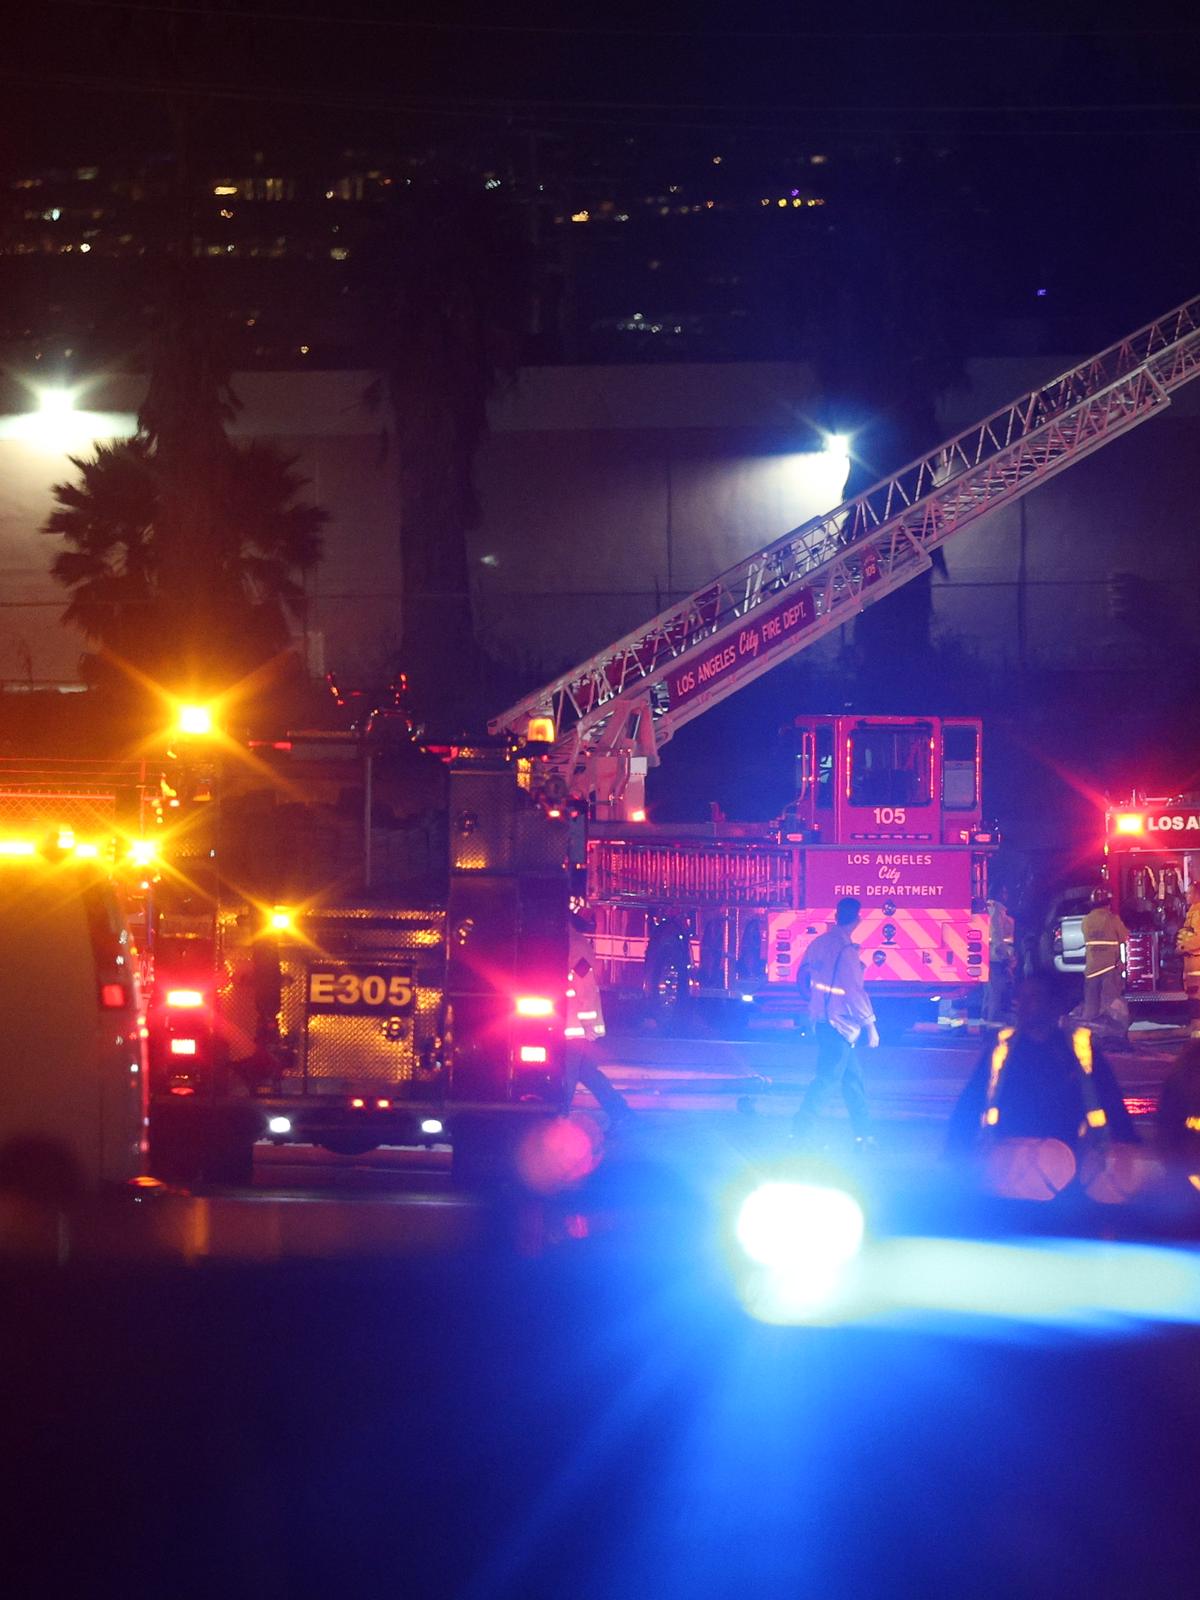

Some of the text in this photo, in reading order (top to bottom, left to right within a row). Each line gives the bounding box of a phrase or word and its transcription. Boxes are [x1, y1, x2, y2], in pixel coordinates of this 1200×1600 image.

[676, 602, 806, 696] LOS ANGELES City FIRE DEPT.
[873, 807, 906, 825] 105
[1148, 816, 1184, 831] LOS
[847, 854, 932, 865] LOS ANGELES
[878, 865, 901, 884] City
[834, 885, 943, 896] FIRE DEPARTMENT
[310, 973, 412, 1006] E305
